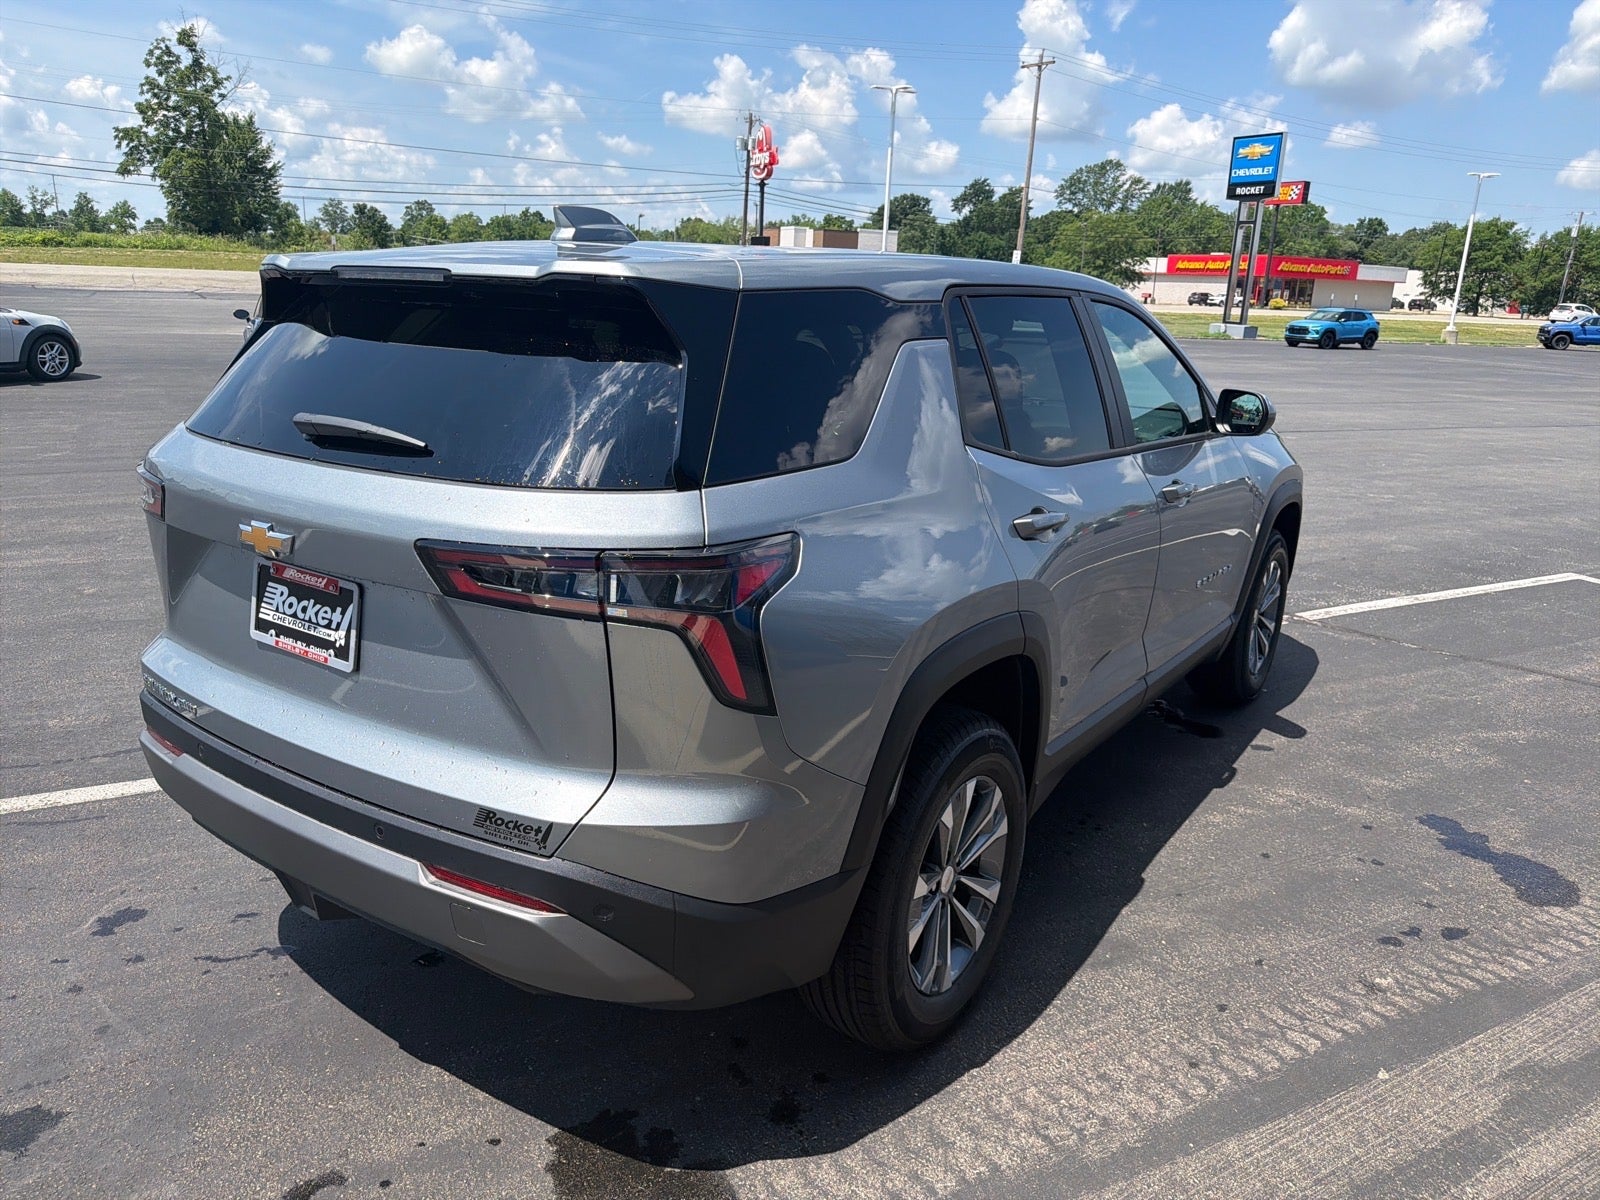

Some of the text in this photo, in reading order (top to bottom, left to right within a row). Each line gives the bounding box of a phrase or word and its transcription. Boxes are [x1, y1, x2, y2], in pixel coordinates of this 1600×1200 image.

[1232, 167, 1274, 177] CHEVROLET
[1236, 186, 1264, 195] ROCKET
[1176, 260, 1205, 269] Advance
[1205, 260, 1225, 270] Auto
[1277, 261, 1344, 275] Advance Auto Parts
[286, 568, 326, 588] Rocket
[261, 583, 344, 630] Rocket
[271, 613, 332, 638] CHEVROLET.COM
[307, 652, 325, 662] OHIO
[477, 808, 544, 837] Rocket
